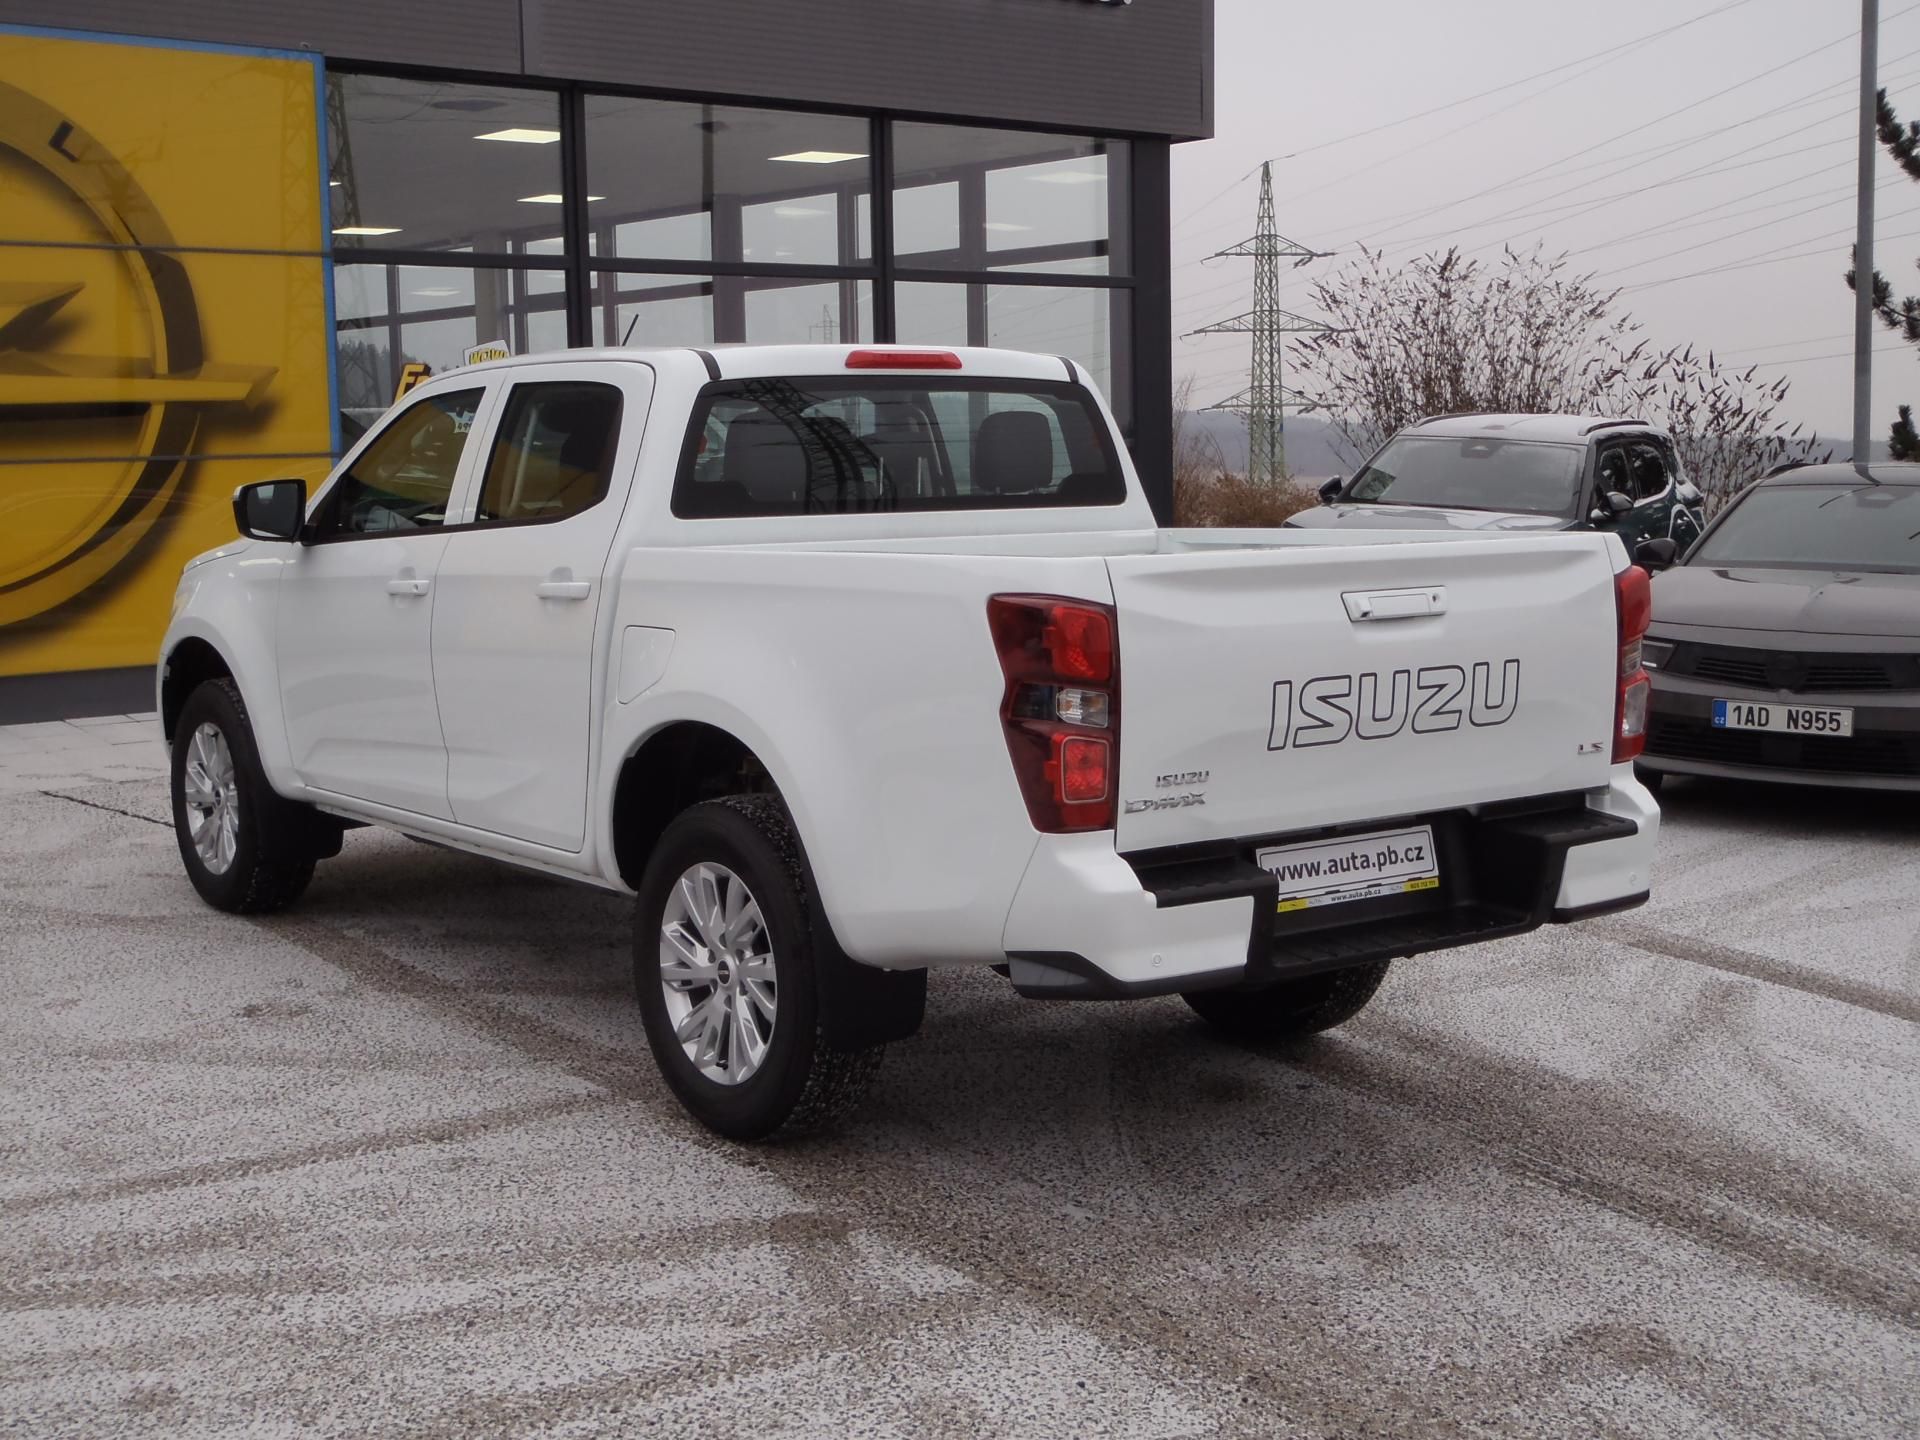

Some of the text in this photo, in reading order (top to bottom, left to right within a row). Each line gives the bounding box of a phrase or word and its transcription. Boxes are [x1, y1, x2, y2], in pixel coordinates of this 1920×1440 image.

[1267, 659, 1520, 751] ISUZU
[1733, 705, 1841, 732] 1AD N955
[1577, 741, 1604, 755] LS
[1155, 770, 1210, 788] ISUZU
[1269, 845, 1425, 882] www.auta.pb.cz
[1330, 888, 1382, 902] www.auta.pb.cz
